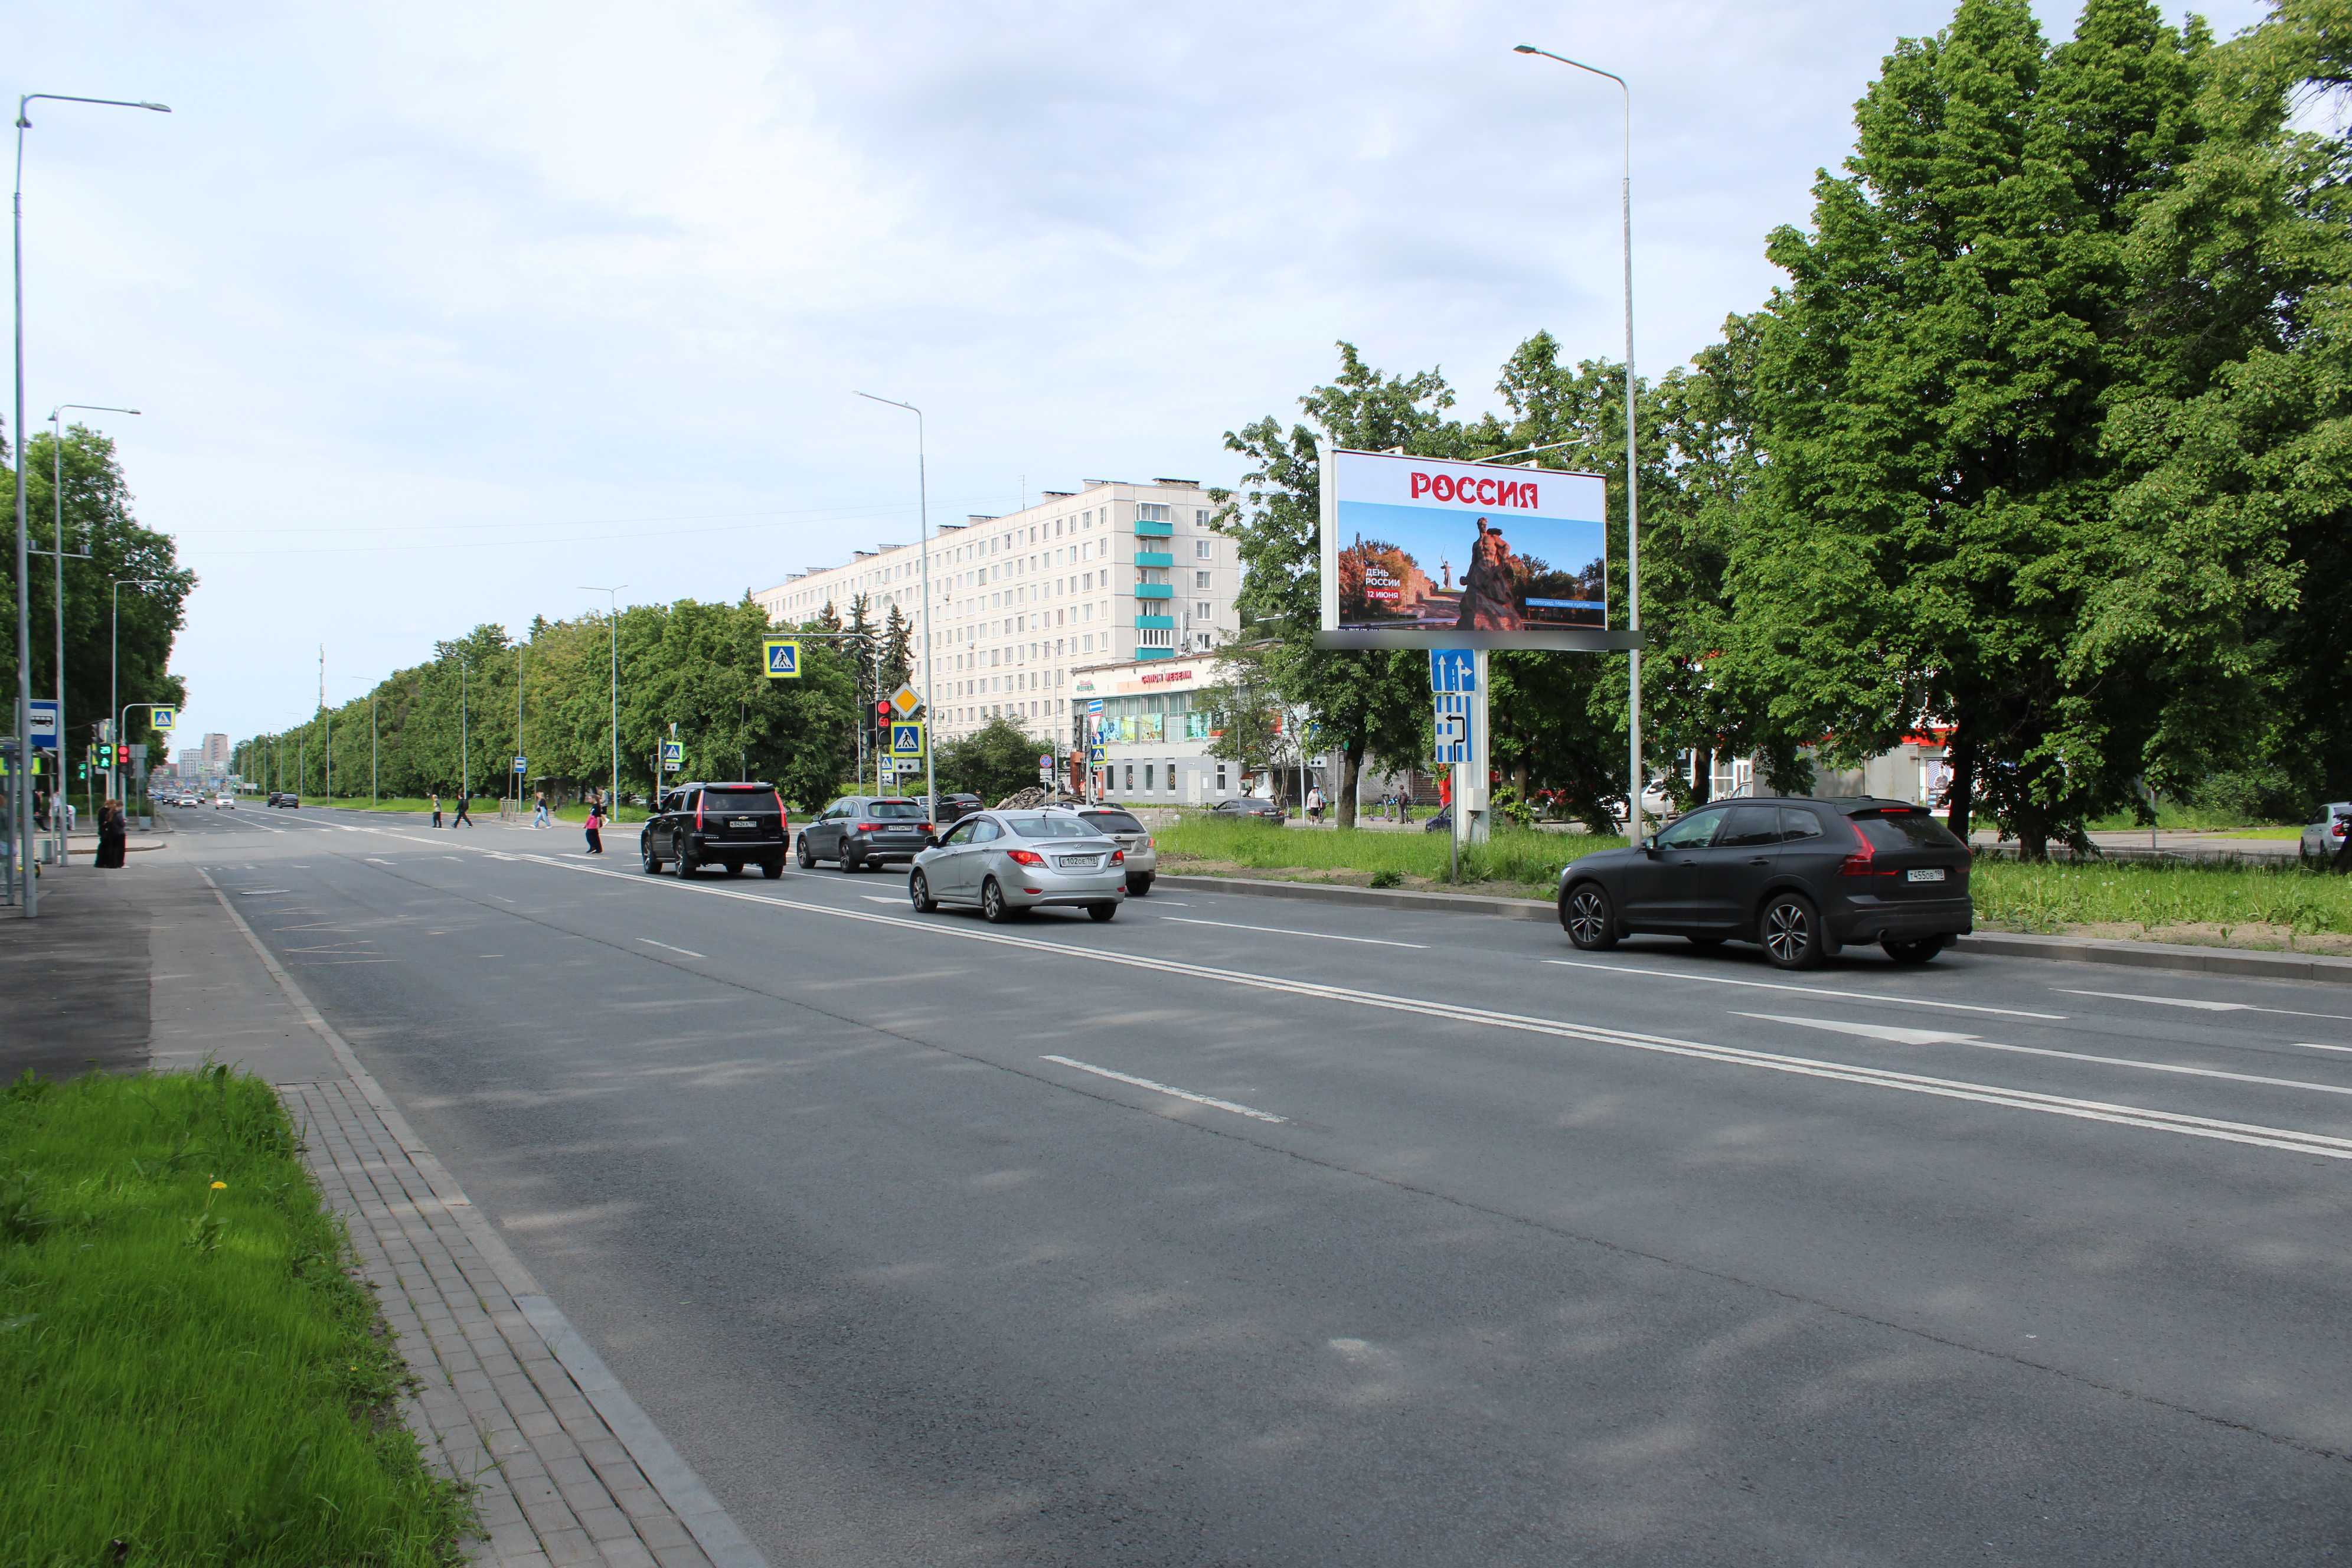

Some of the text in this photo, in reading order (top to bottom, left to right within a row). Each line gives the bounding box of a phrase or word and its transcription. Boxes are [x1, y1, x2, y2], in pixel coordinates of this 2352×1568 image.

[1412, 472, 1538, 508] РОССИЯ
[1366, 568, 1389, 577] ДЕНЬ
[1366, 577, 1400, 586] РОССИИ
[880, 718, 888, 727] 60
